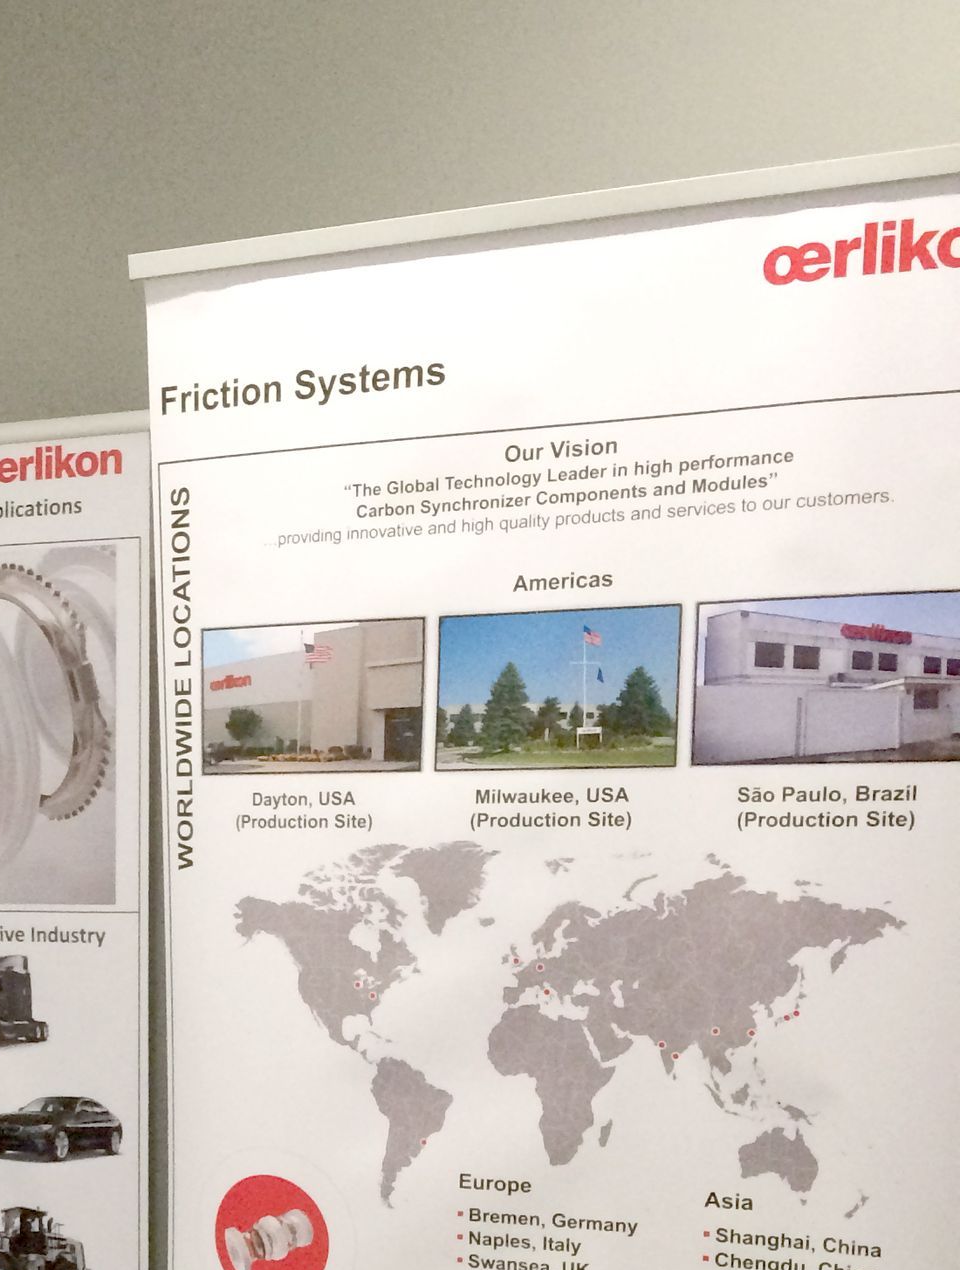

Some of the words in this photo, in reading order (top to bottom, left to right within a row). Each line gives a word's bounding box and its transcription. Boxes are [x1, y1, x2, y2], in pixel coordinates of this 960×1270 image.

[162, 378, 281, 415] Friction
[295, 363, 445, 405] Systems
[505, 445, 544, 462] Our
[551, 439, 617, 458] Vision
[387, 478, 439, 494] Global
[445, 472, 541, 490] Technology
[548, 465, 607, 482] Leader
[613, 464, 627, 477] in
[635, 459, 672, 478] high
[679, 452, 793, 475] performance
[357, 503, 414, 518] Carbon
[421, 495, 531, 516] Synchronizer
[536, 485, 647, 506] Components
[653, 480, 685, 496] and
[346, 522, 424, 541] innovative
[427, 520, 457, 535] and
[462, 517, 493, 535] high
[499, 514, 550, 533] quality
[555, 509, 625, 529] products
[631, 505, 661, 520] and
[667, 501, 736, 518] services
[742, 499, 756, 512] to
[763, 498, 791, 510] our
[171, 486, 192, 667] LOCATIONS
[513, 572, 613, 592] Americas
[174, 677, 194, 871] WORLDWIDE
[253, 793, 312, 809] Dayton,
[319, 791, 355, 805] USA
[476, 789, 579, 805] Milwaukee,
[587, 787, 629, 802] USA
[738, 787, 774, 802] São
[782, 786, 846, 804] Paulo,
[856, 785, 917, 801] Brazil
[236, 815, 328, 832] (Production
[335, 814, 372, 831] Site)
[31, 926, 105, 947] Industry
[460, 1173, 531, 1196] Europe
[705, 1192, 752, 1210] Asia
[469, 1208, 545, 1228] Bremen,
[552, 1213, 638, 1237] Germany
[469, 1231, 535, 1251] Naples,
[543, 1236, 581, 1256] Italy
[716, 1228, 815, 1253] Shanghai,
[823, 1238, 881, 1257] China
